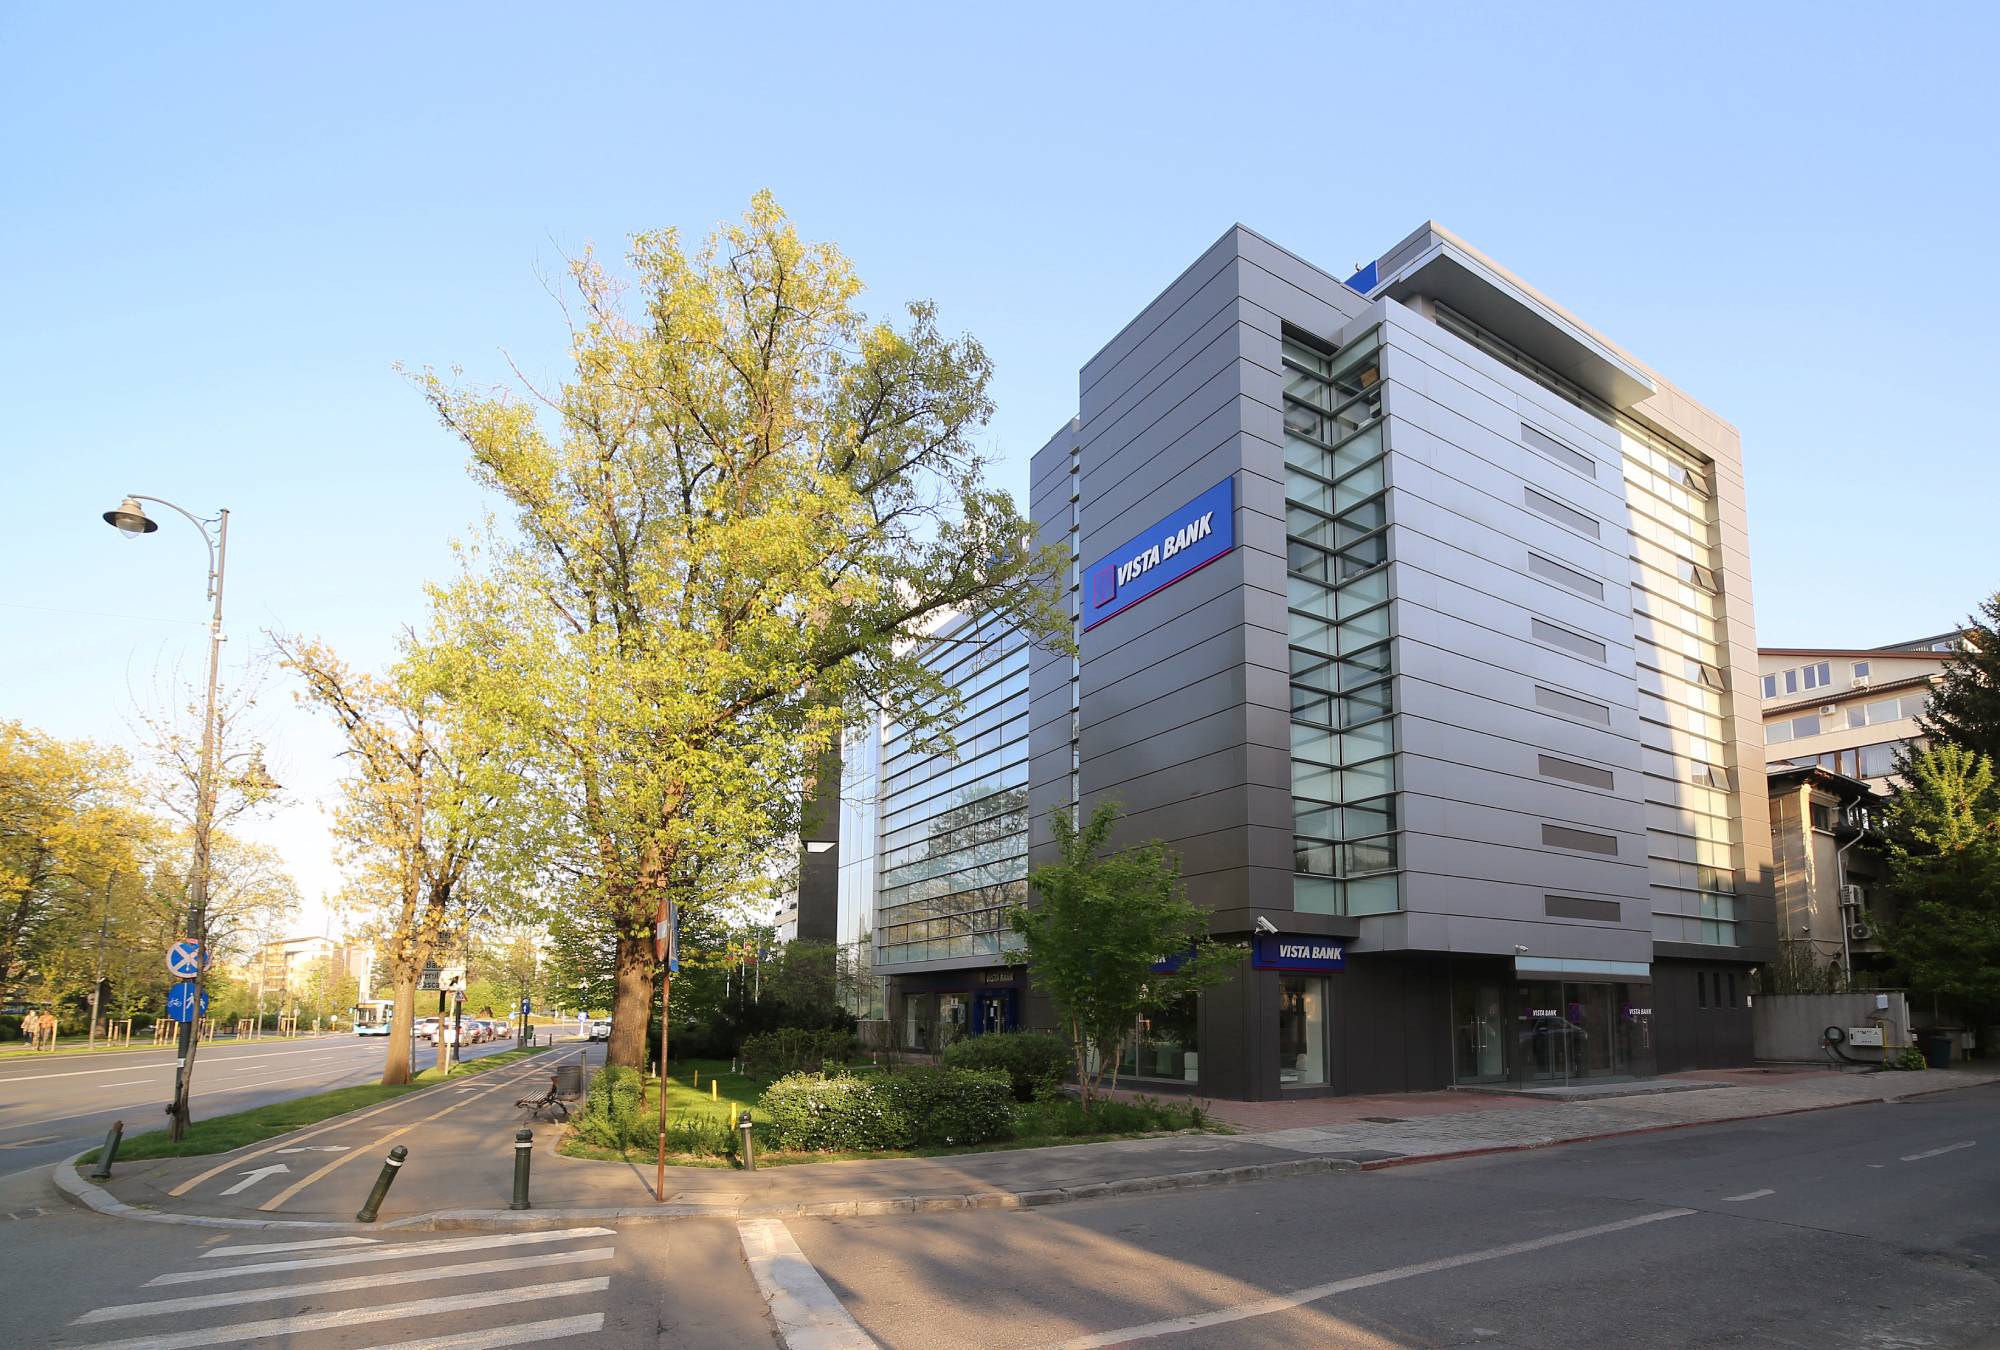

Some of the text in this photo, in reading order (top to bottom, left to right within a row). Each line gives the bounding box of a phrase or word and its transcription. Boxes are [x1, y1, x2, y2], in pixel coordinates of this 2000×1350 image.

[1117, 511, 1214, 586] VISTA BANK
[1279, 944, 1342, 960] VISTA BANK
[1532, 1009, 1557, 1017] VISTA BANK
[1629, 1008, 1640, 1016] VISTA
